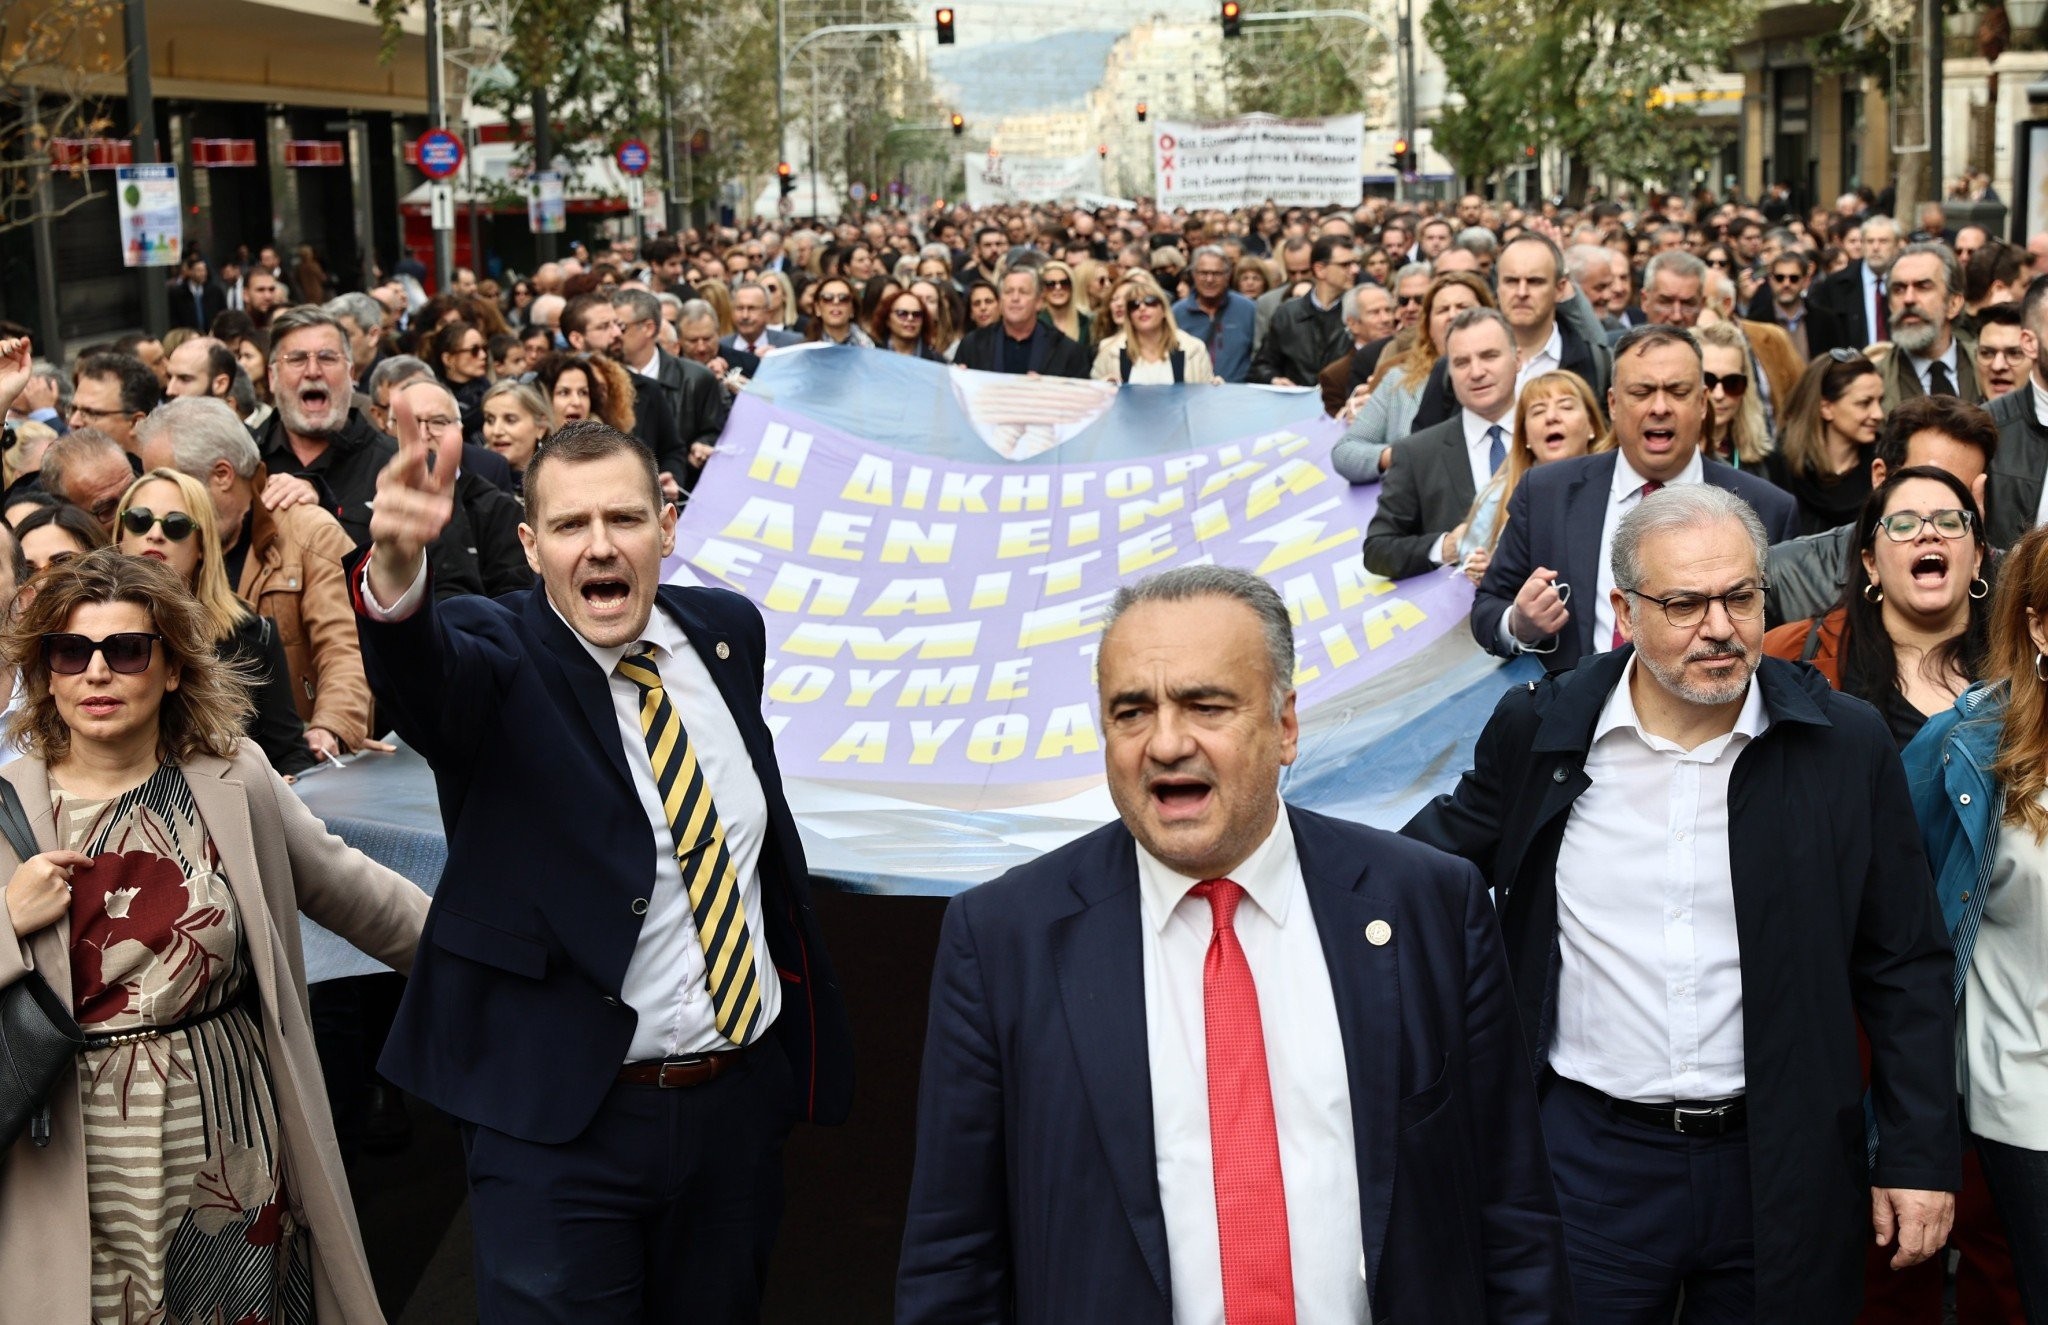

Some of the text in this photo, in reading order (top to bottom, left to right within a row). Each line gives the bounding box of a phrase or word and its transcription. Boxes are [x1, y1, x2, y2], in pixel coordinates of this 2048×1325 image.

[747, 421, 1300, 513] Η ΔΙΚΗΓΟΡΙΑ
[691, 457, 1328, 616] ΕΠΑΙΤΕΙΑ
[718, 495, 958, 563] ΔΕΝ
[763, 656, 1034, 708] ΟΥΜΕ
